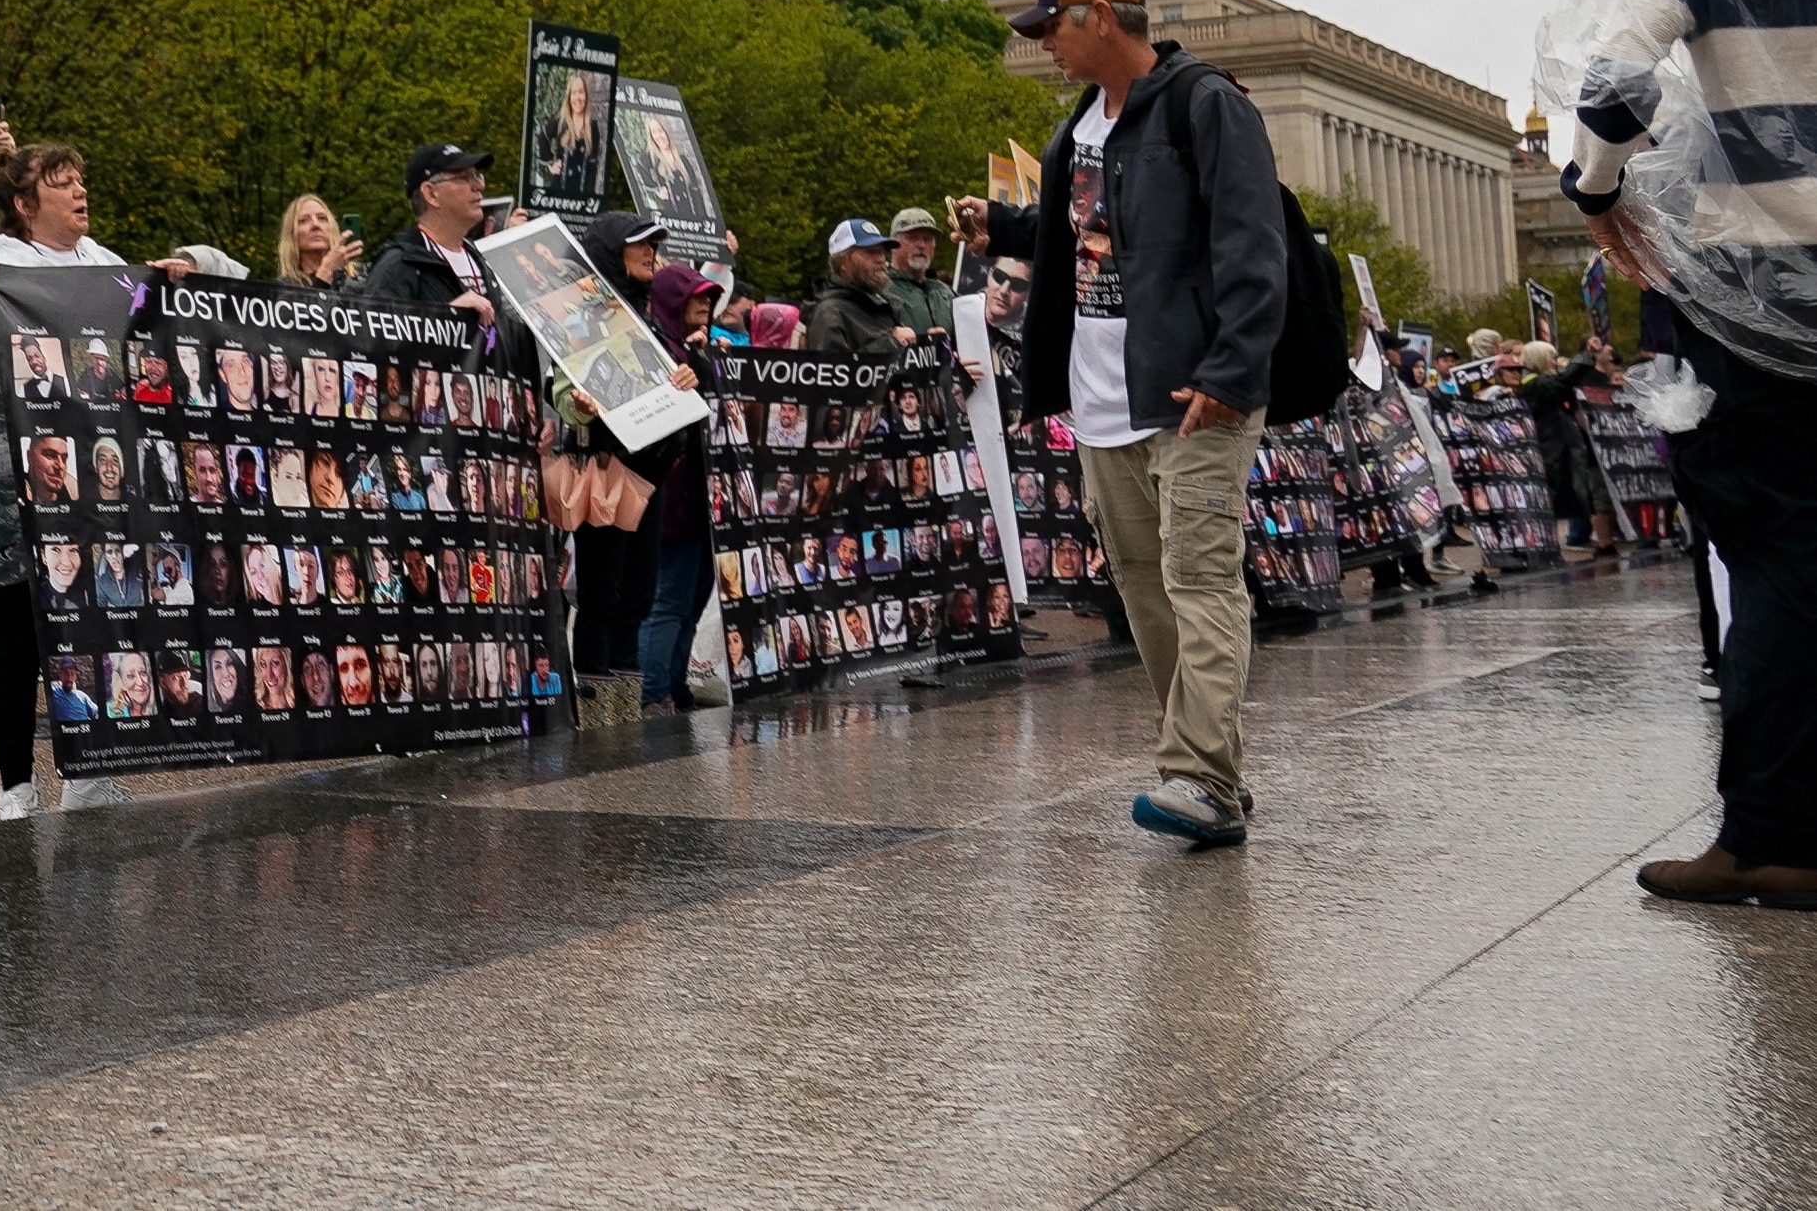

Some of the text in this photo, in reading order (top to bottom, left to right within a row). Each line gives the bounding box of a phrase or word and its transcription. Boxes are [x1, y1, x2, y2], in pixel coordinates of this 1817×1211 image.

[530, 189, 601, 215] Forever 21
[650, 211, 703, 230] Forever
[160, 285, 472, 350] LOST VOICES OF FENTANYL
[753, 359, 850, 387] VOICES
